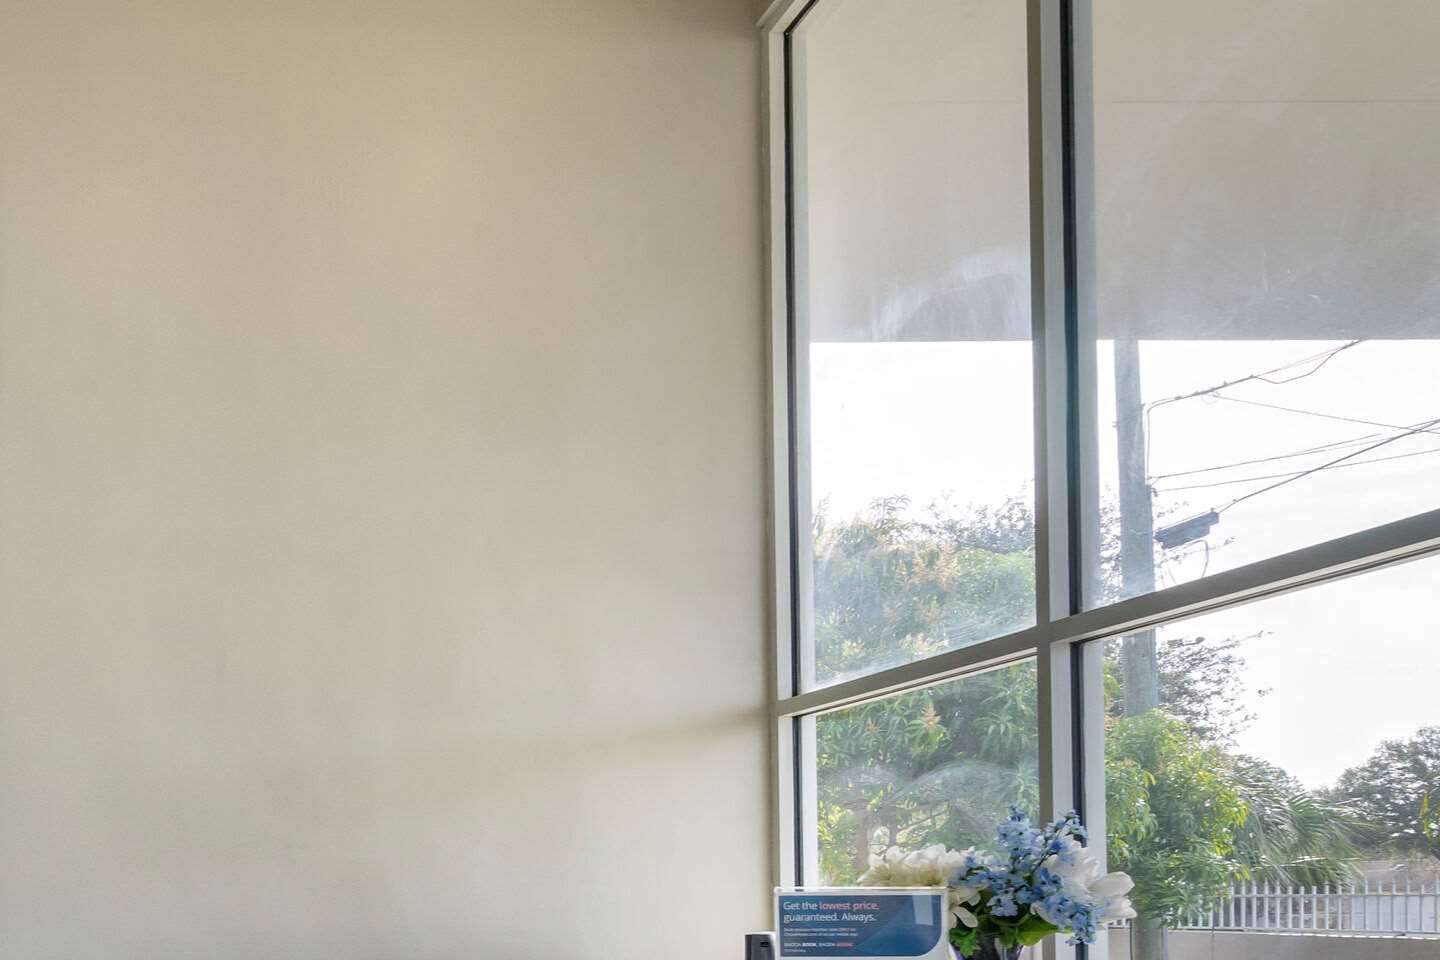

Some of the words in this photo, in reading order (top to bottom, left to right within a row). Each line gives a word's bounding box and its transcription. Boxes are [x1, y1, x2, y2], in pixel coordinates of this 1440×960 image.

[783, 901, 800, 910] Get
[801, 901, 818, 910] the
[819, 901, 851, 910] lowest
[783, 912, 840, 924] guaranteed.
[841, 912, 877, 924] Always.
